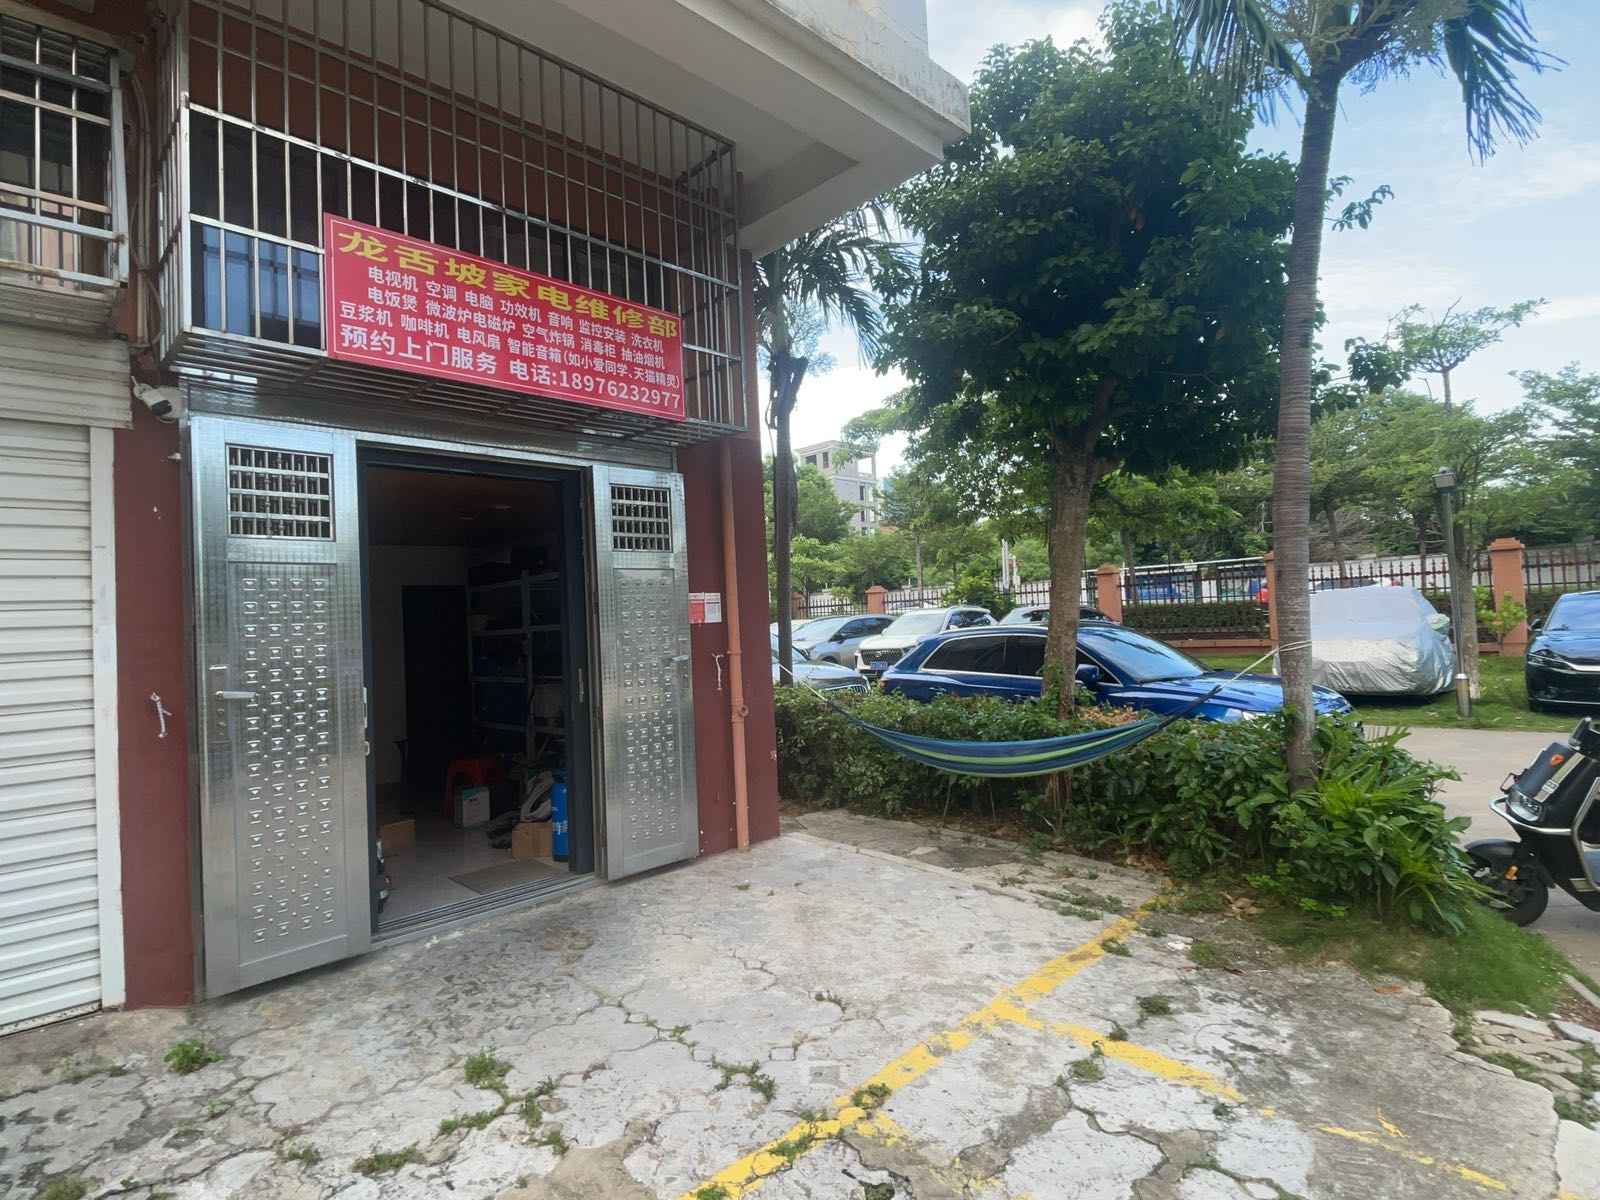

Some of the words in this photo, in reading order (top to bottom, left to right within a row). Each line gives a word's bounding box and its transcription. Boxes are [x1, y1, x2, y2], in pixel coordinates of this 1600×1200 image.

[338, 231, 677, 338] 龙舌坡家电维修部
[339, 301, 393, 327] 豆浆机
[401, 314, 449, 339] 咖啡机
[457, 327, 500, 350] 电风扇
[368, 266, 418, 292] 电视机
[426, 280, 457, 302] 空调
[465, 290, 493, 311] 电脑
[548, 311, 573, 331] 音响
[579, 319, 626, 344] 监控安装
[631, 332, 664, 353] 洗衣机
[340, 324, 497, 374] 预约上门服务
[368, 287, 418, 313] 电饭煲
[522, 323, 575, 348] 空气炸锅
[580, 337, 616, 358] 消毒柜
[621, 347, 665, 369] 抽油烟机
